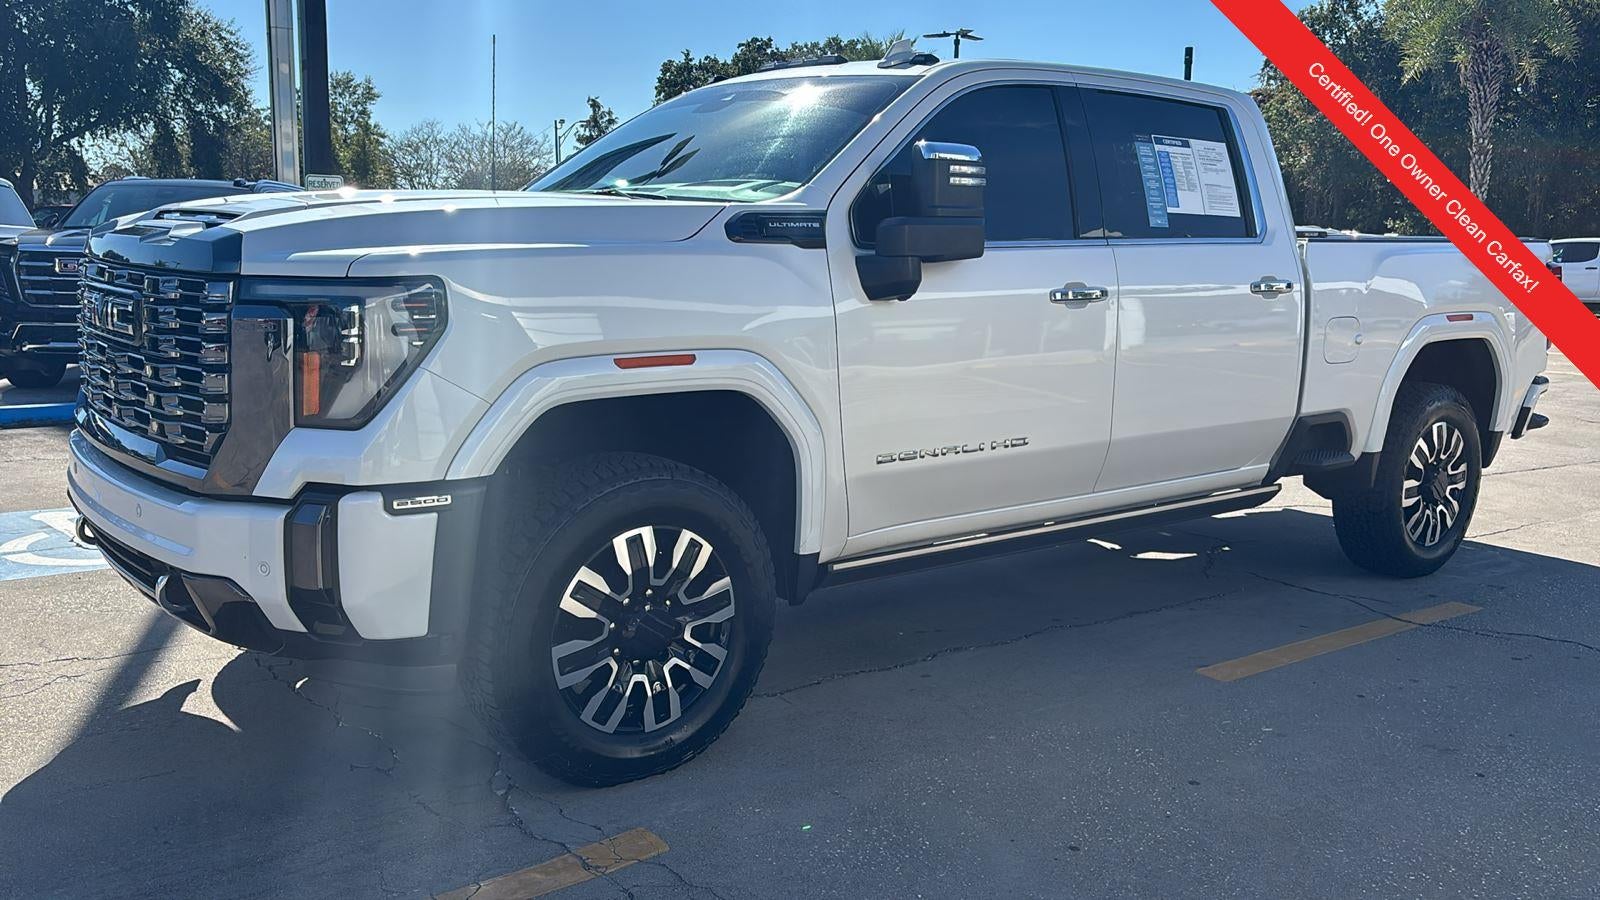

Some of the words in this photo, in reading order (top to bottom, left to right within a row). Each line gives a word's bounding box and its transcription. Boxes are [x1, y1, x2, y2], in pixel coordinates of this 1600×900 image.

[876, 442, 985, 465] DENALI
[990, 437, 1030, 451] HD
[397, 498, 448, 506] 2500
